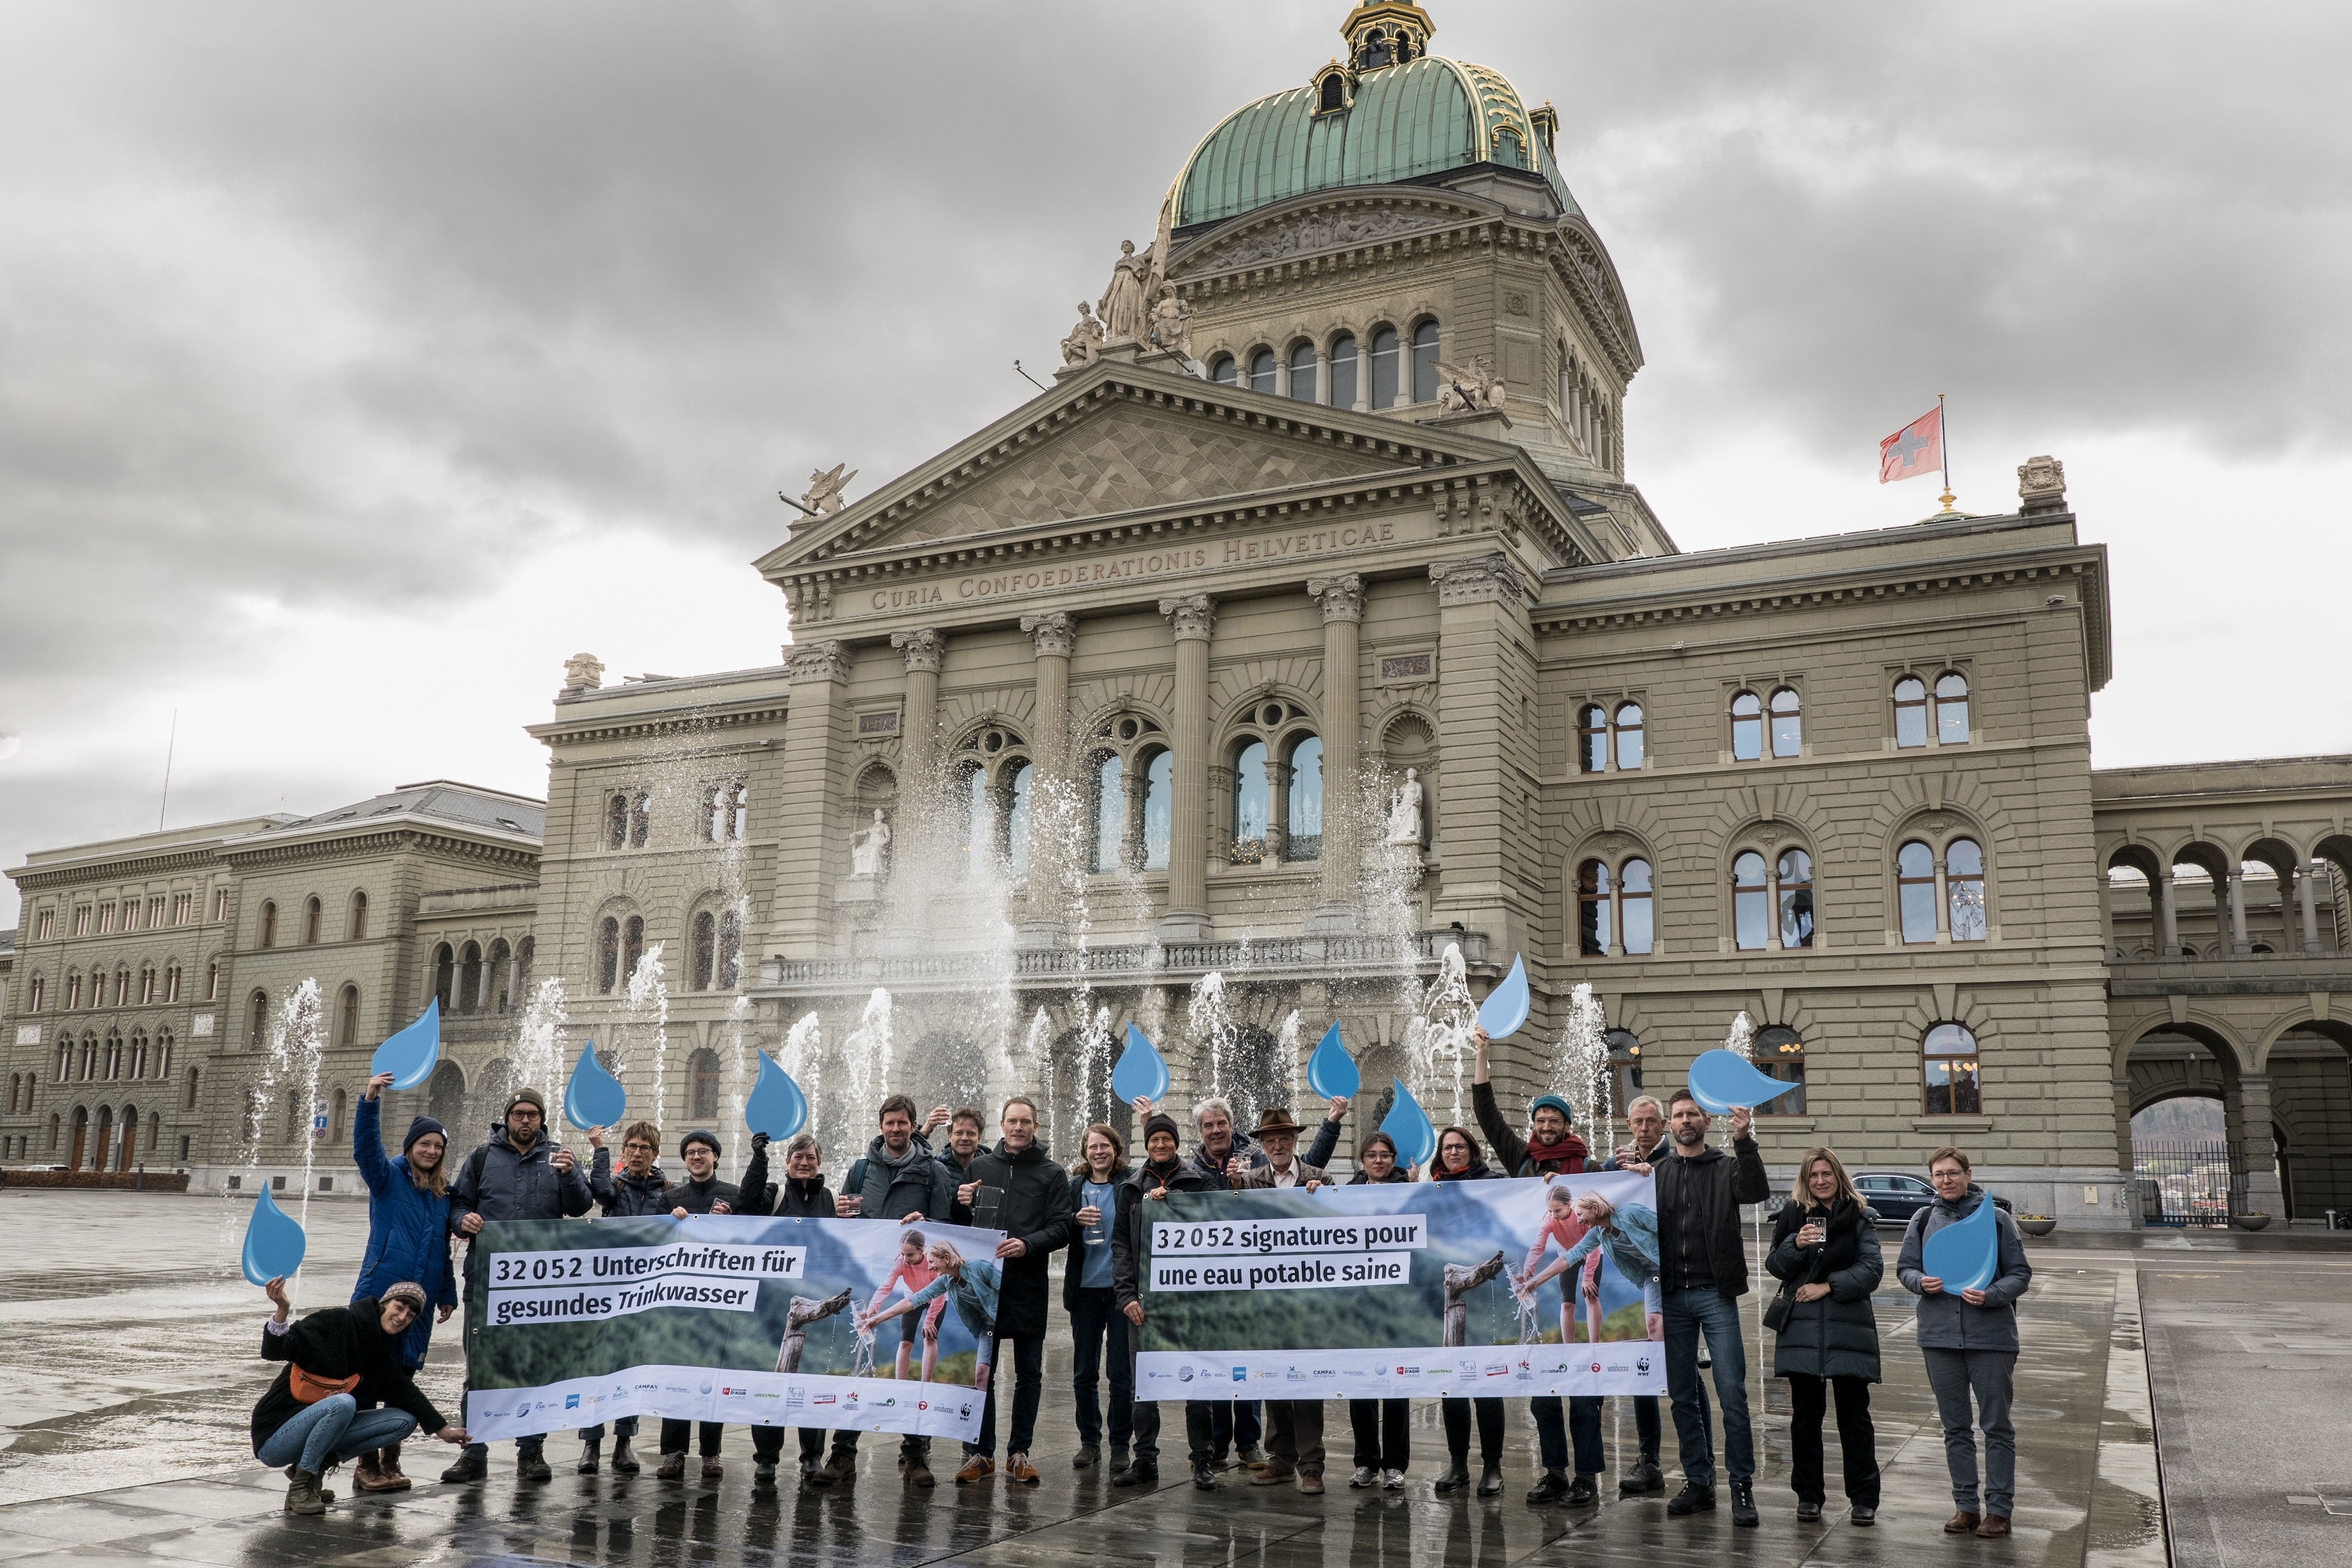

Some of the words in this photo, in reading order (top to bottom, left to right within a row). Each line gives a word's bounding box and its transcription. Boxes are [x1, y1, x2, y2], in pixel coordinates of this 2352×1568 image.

[871, 587, 943, 609] CURIA
[957, 548, 1205, 597] CONFOEDERATIONIS
[1223, 522, 1394, 562] HELVETICAE
[1240, 1223, 1358, 1253] signatures
[1365, 1225, 1418, 1249] pour
[593, 1247, 755, 1277] Unterschriften
[762, 1250, 797, 1273] für
[1158, 1268, 1198, 1285] une
[1204, 1267, 1243, 1285] eau
[1249, 1260, 1336, 1289] potable
[1341, 1257, 1401, 1282] saine
[496, 1292, 612, 1325] gesundes
[619, 1282, 749, 1310] Trinkwasser
[612, 1390, 629, 1399] BirdLife
[933, 1405, 954, 1413] uniterre
